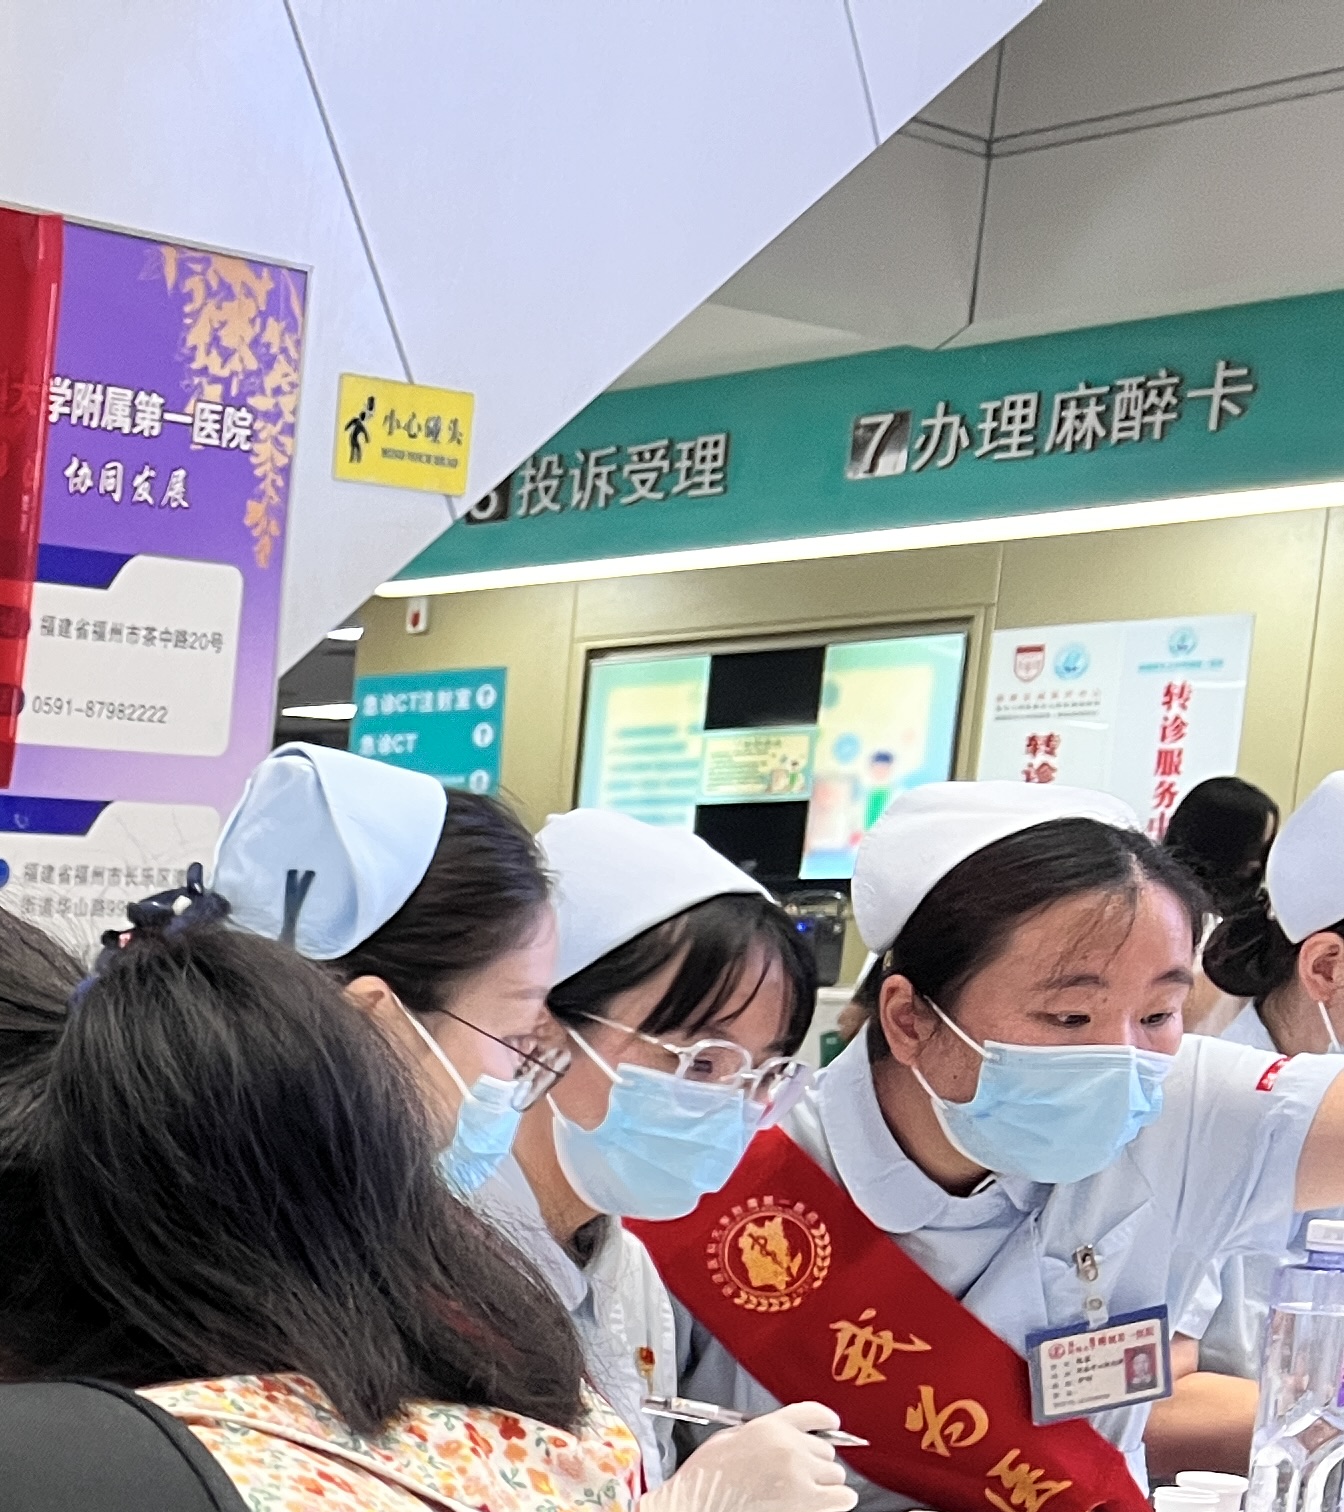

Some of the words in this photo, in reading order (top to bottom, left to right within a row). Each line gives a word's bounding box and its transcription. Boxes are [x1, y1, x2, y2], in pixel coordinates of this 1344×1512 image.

[63, 455, 190, 509] 协同发展
[515, 431, 728, 519] 投诉受理
[31, 695, 169, 725] 0591-87982222
